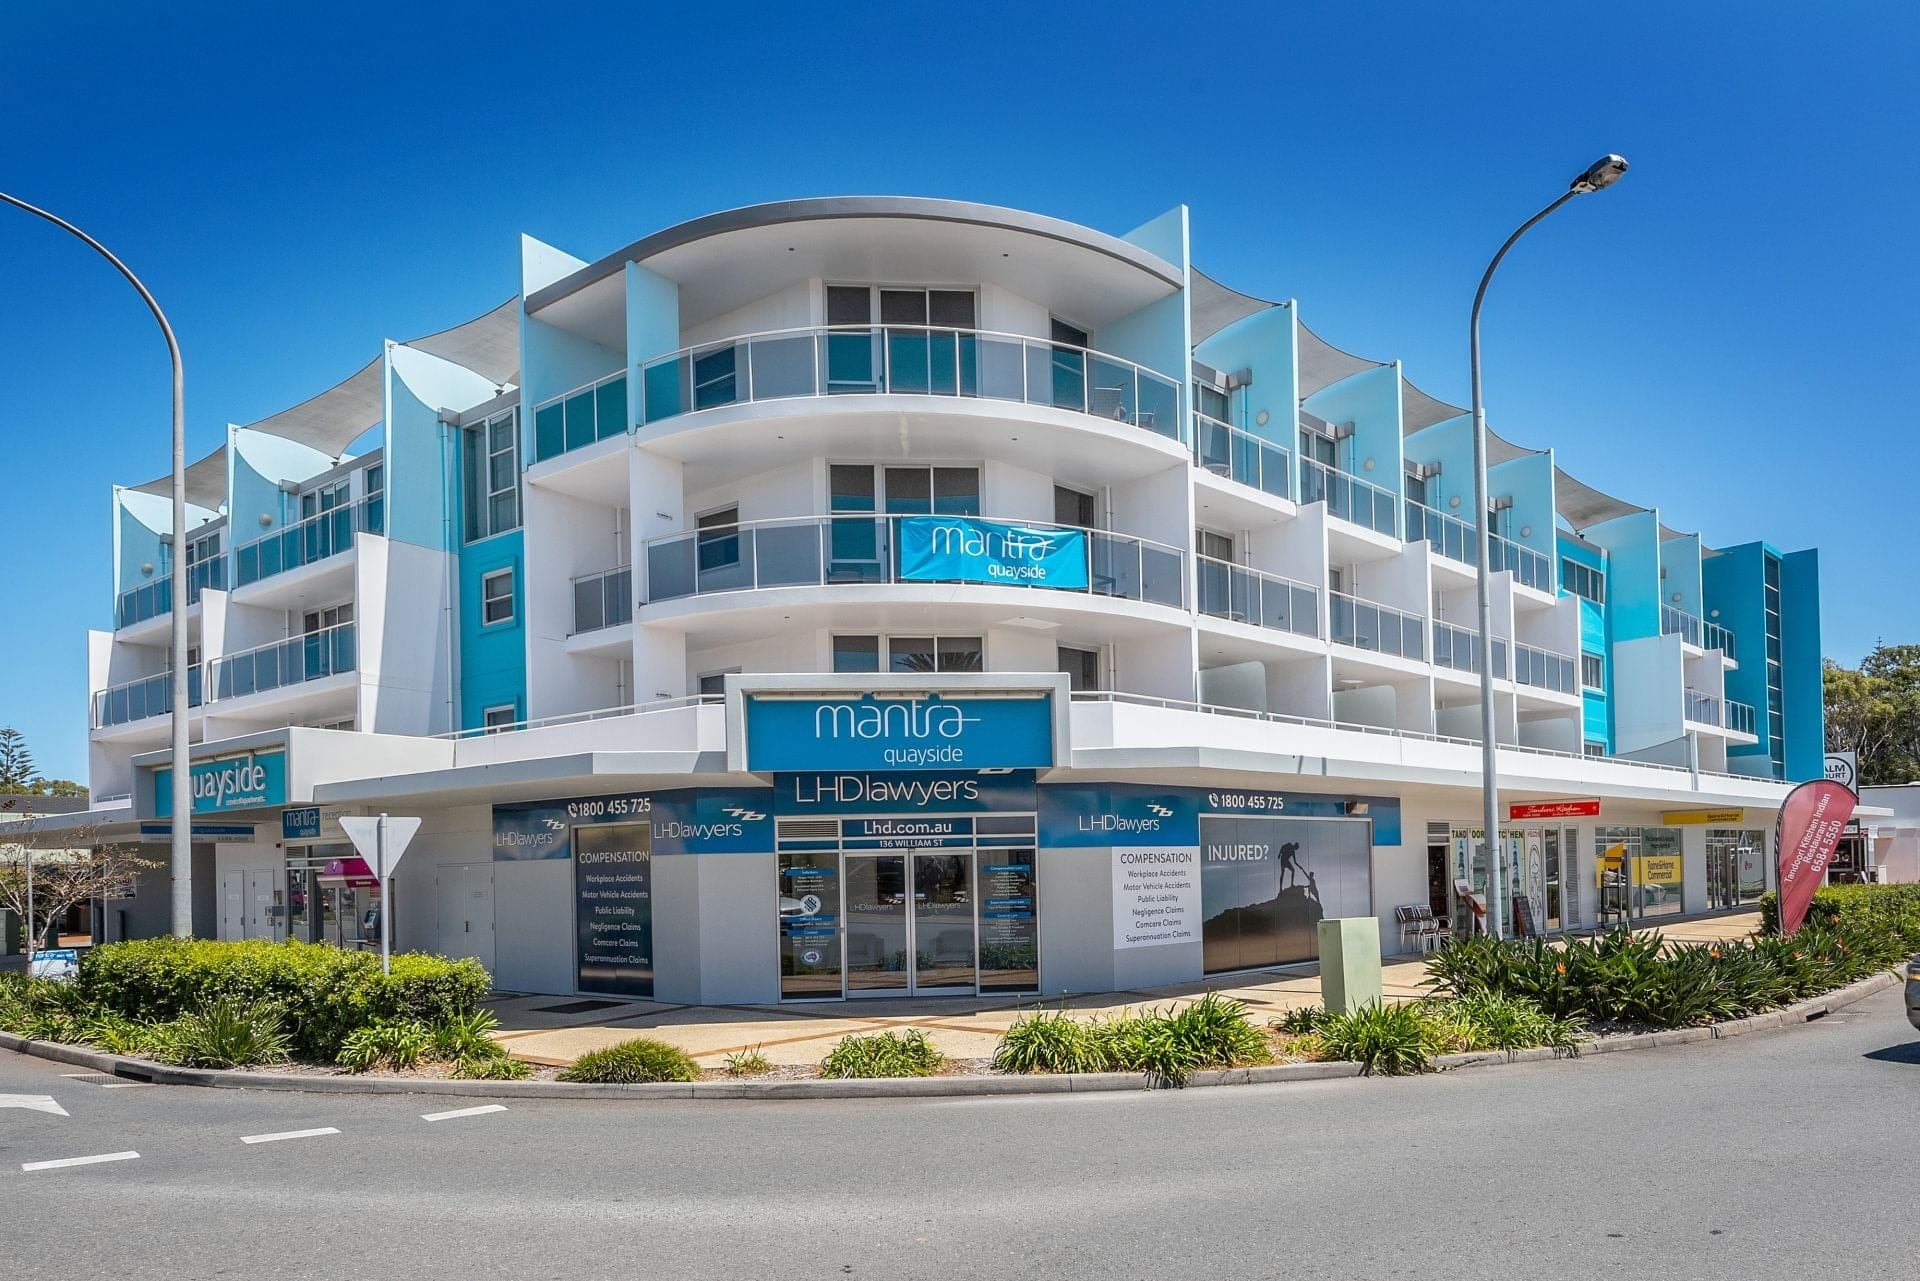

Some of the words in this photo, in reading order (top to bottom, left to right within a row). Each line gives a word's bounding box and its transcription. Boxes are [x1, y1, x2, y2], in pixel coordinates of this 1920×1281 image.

[932, 526, 1056, 561] mantra
[988, 563, 1047, 580] quayside
[816, 700, 981, 739] mantra
[884, 744, 964, 767] quayside
[795, 775, 979, 806] LHDlawyers
[578, 802, 604, 817] 1800
[607, 800, 628, 815] 455
[630, 798, 651, 813] 725
[1221, 795, 1245, 808] 1800
[1247, 796, 1265, 809] 455
[1267, 796, 1284, 810] 725
[286, 810, 319, 827] mantra
[1079, 815, 1160, 834] LHDlawyers
[654, 821, 743, 840] LHDlawyers
[864, 820, 952, 835] Lhd.com.au
[496, 832, 553, 848] LHDlawyers
[880, 840, 894, 848] 136
[895, 839, 932, 848] WILLIAM
[933, 839, 944, 847] ST
[1783, 848, 1805, 882] Tandoori
[1799, 817, 1820, 849] Kitchen
[1812, 793, 1832, 818] Indian
[1802, 820, 1829, 864] Restaurant
[1208, 844, 1269, 861] INJURED?
[1810, 847, 1830, 872] 6584
[1823, 820, 1842, 845] 5550
[580, 850, 649, 864] COMPENSATION
[1120, 853, 1192, 864] COMPENSATION
[586, 874, 615, 884] Workplace
[615, 873, 643, 882] Accidents
[1127, 869, 1159, 879] Workplace
[1160, 868, 1187, 877] Accidents
[1123, 883, 1141, 891] Motor
[1142, 882, 1163, 890] Vehicle
[1164, 881, 1191, 889] Accidents
[600, 890, 620, 899] Vehicle
[620, 890, 649, 899] Accidents
[1137, 895, 1155, 903] Public
[1156, 894, 1178, 902] Liability
[595, 906, 612, 915] Public
[613, 906, 635, 916] Liability
[1132, 908, 1164, 917] Negligence
[1165, 906, 1185, 914] Claims
[590, 922, 621, 932] Negligence
[621, 922, 641, 931] Claims
[1162, 918, 1182, 926] Claims
[619, 938, 639, 947] Claims
[1126, 933, 1171, 944] Superannuation
[1172, 930, 1191, 938] Claims
[628, 955, 649, 964] Claims
